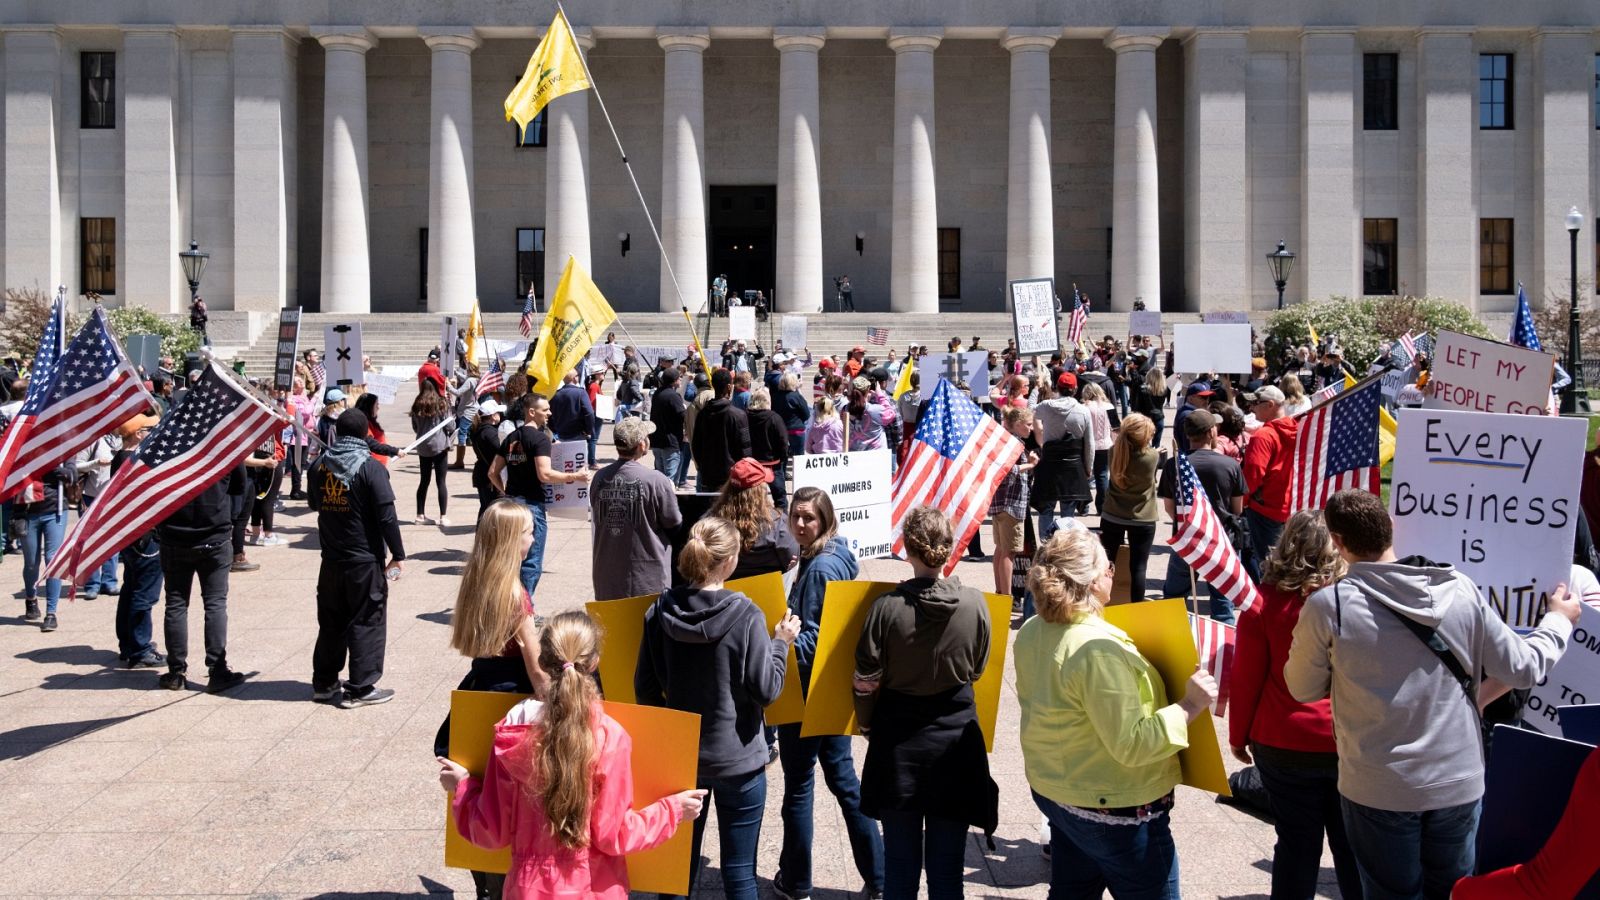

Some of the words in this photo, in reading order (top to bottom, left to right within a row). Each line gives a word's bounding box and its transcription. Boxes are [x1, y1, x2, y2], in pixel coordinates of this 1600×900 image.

[1018, 324, 1034, 334] STOP
[1446, 345, 1481, 369] LET
[1496, 359, 1526, 381] MY
[1434, 380, 1496, 413] PEOPLE
[805, 454, 849, 469] ACTON'S
[1425, 419, 1542, 483] Every
[544, 484, 554, 504] ICH
[555, 493, 565, 502] &
[577, 487, 588, 499] IS
[831, 480, 872, 494] NUMBERS
[840, 509, 870, 523] EQUAL
[1395, 482, 1569, 529] Business
[1461, 530, 1486, 563] is
[1573, 628, 1600, 655] OM
[1561, 684, 1586, 705] TO
[1528, 695, 1560, 726] OR
